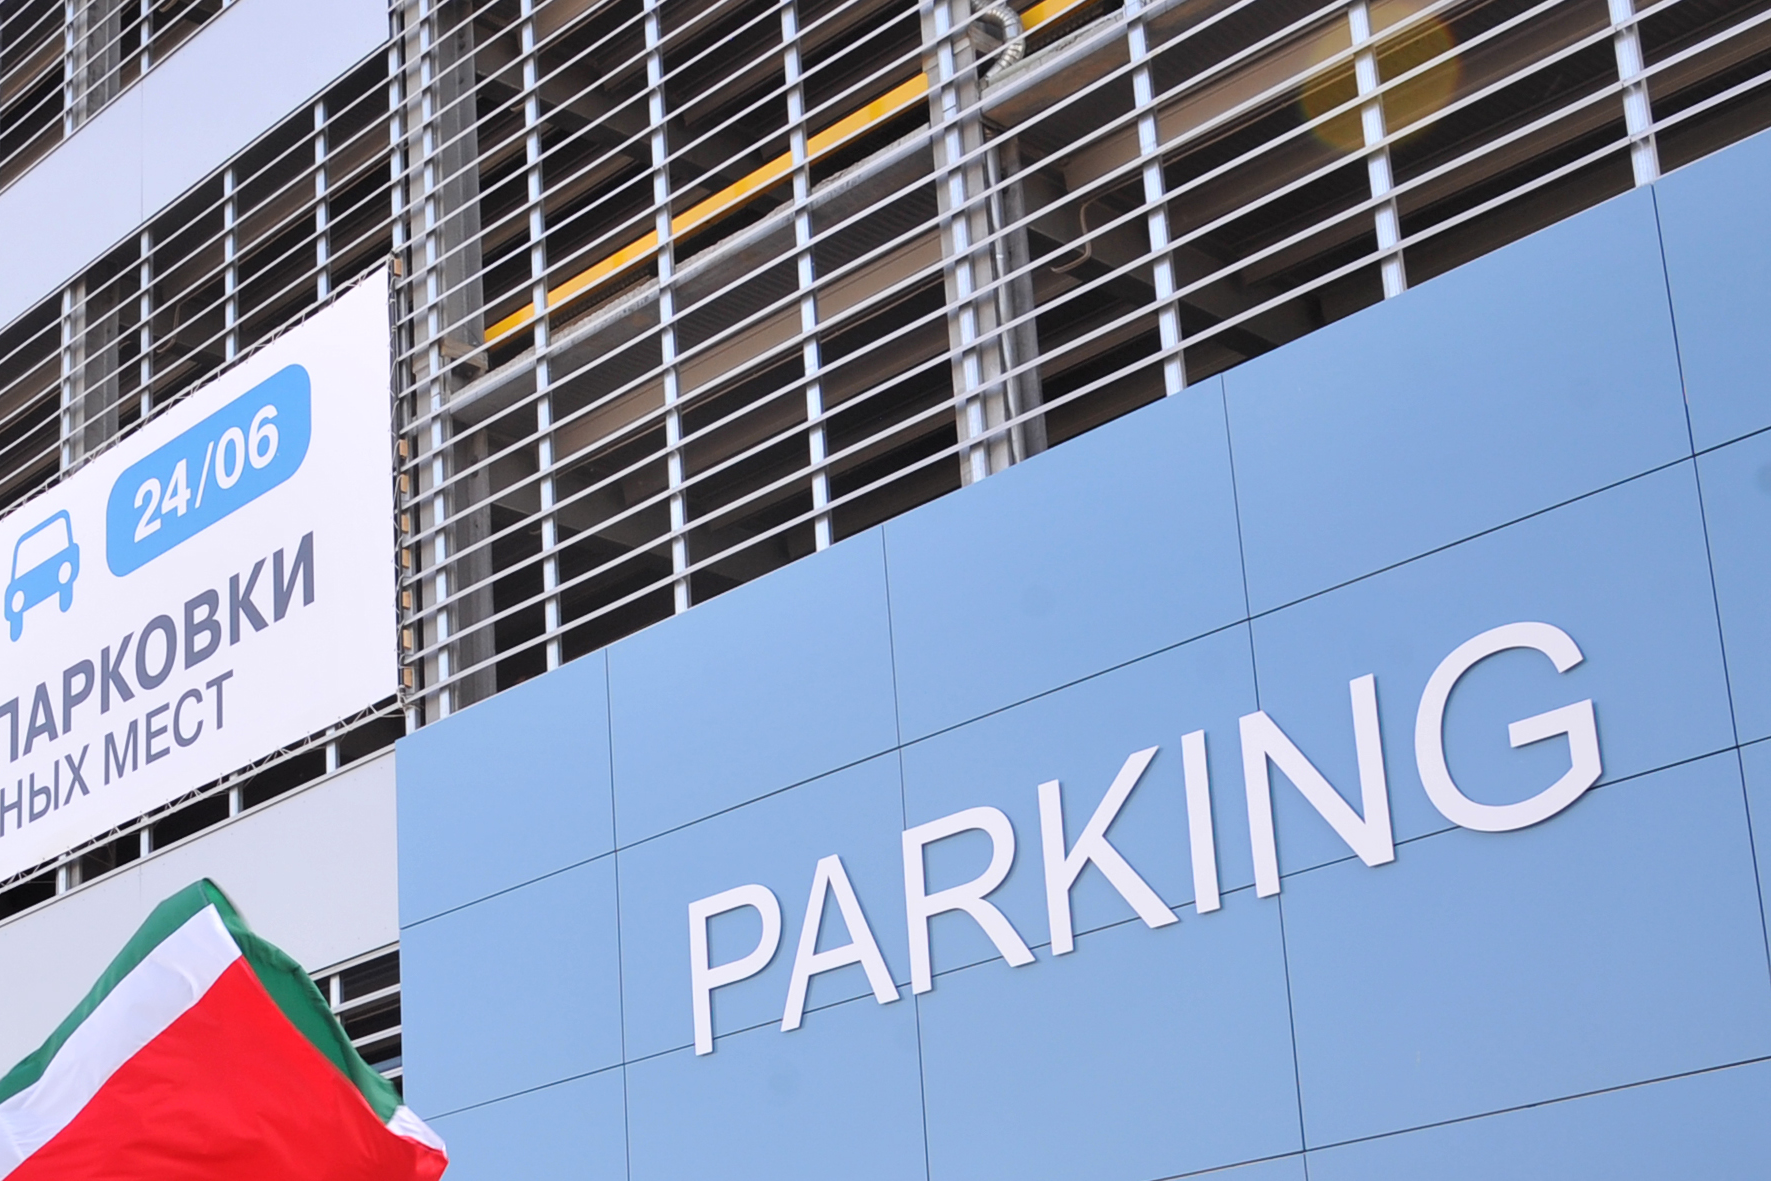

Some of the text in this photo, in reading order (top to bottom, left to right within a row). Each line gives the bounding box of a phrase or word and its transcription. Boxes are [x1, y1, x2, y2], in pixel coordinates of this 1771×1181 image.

[133, 403, 280, 544] 24/06
[103, 668, 234, 786] МЕСТ
[687, 620, 1605, 1057] PARKING
